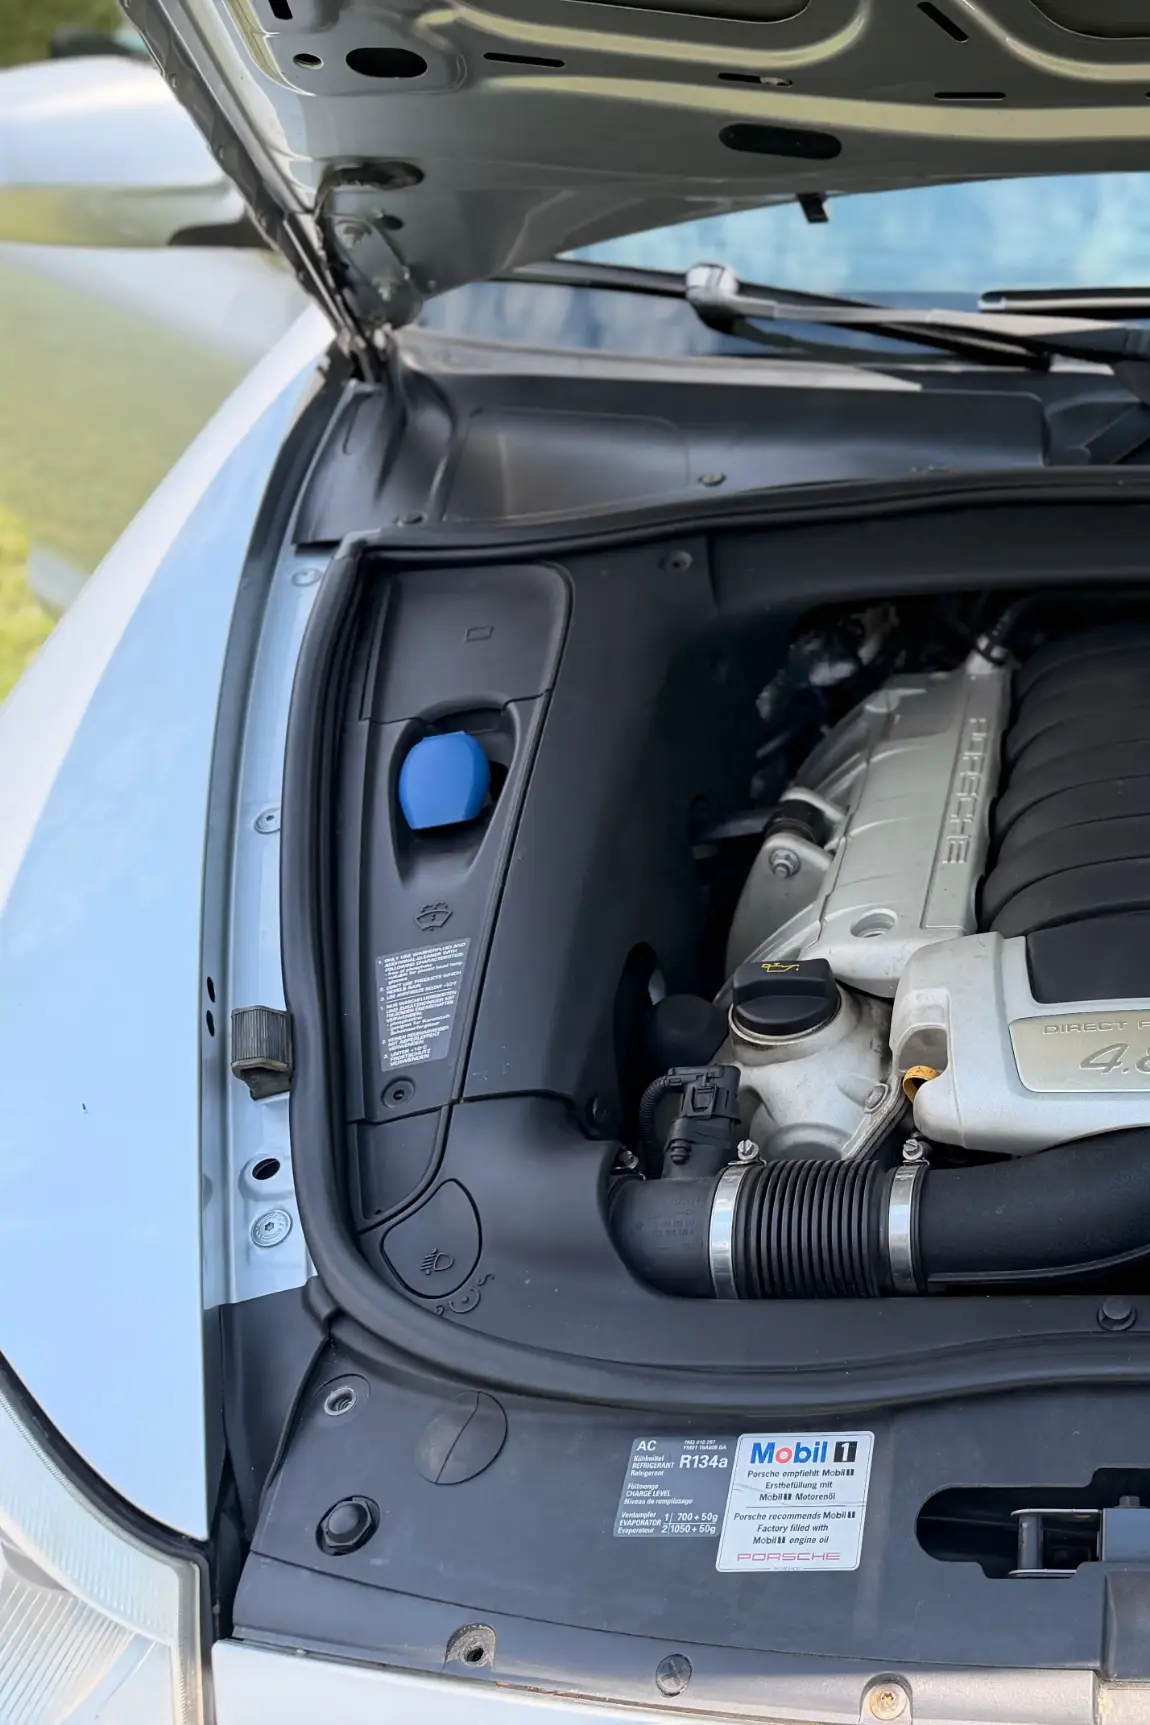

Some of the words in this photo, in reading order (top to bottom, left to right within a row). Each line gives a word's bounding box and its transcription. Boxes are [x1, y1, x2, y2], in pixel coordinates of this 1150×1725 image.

[1042, 1020, 1128, 1035] DIRECT
[636, 1440, 657, 1451] AC
[750, 1441, 828, 1464] Mobil
[679, 1455, 728, 1469] R134a
[747, 1470, 780, 1478] Porsche
[782, 1469, 820, 1478] empfiehlt
[765, 1481, 817, 1490] Erstbefüllung
[820, 1481, 833, 1489] mit
[795, 1492, 836, 1501] Motorenöl
[677, 1513, 693, 1521] 700
[701, 1513, 718, 1523] 50g
[734, 1512, 766, 1521] Porsche
[769, 1512, 821, 1520] recommends
[671, 1525, 691, 1533] 1050
[699, 1525, 716, 1534] 50g
[757, 1524, 788, 1533] Factory
[790, 1524, 811, 1532] filled
[812, 1524, 829, 1532] with
[789, 1536, 816, 1545] engine
[819, 1536, 829, 1544] oil
[737, 1552, 841, 1561] PORSCHE
